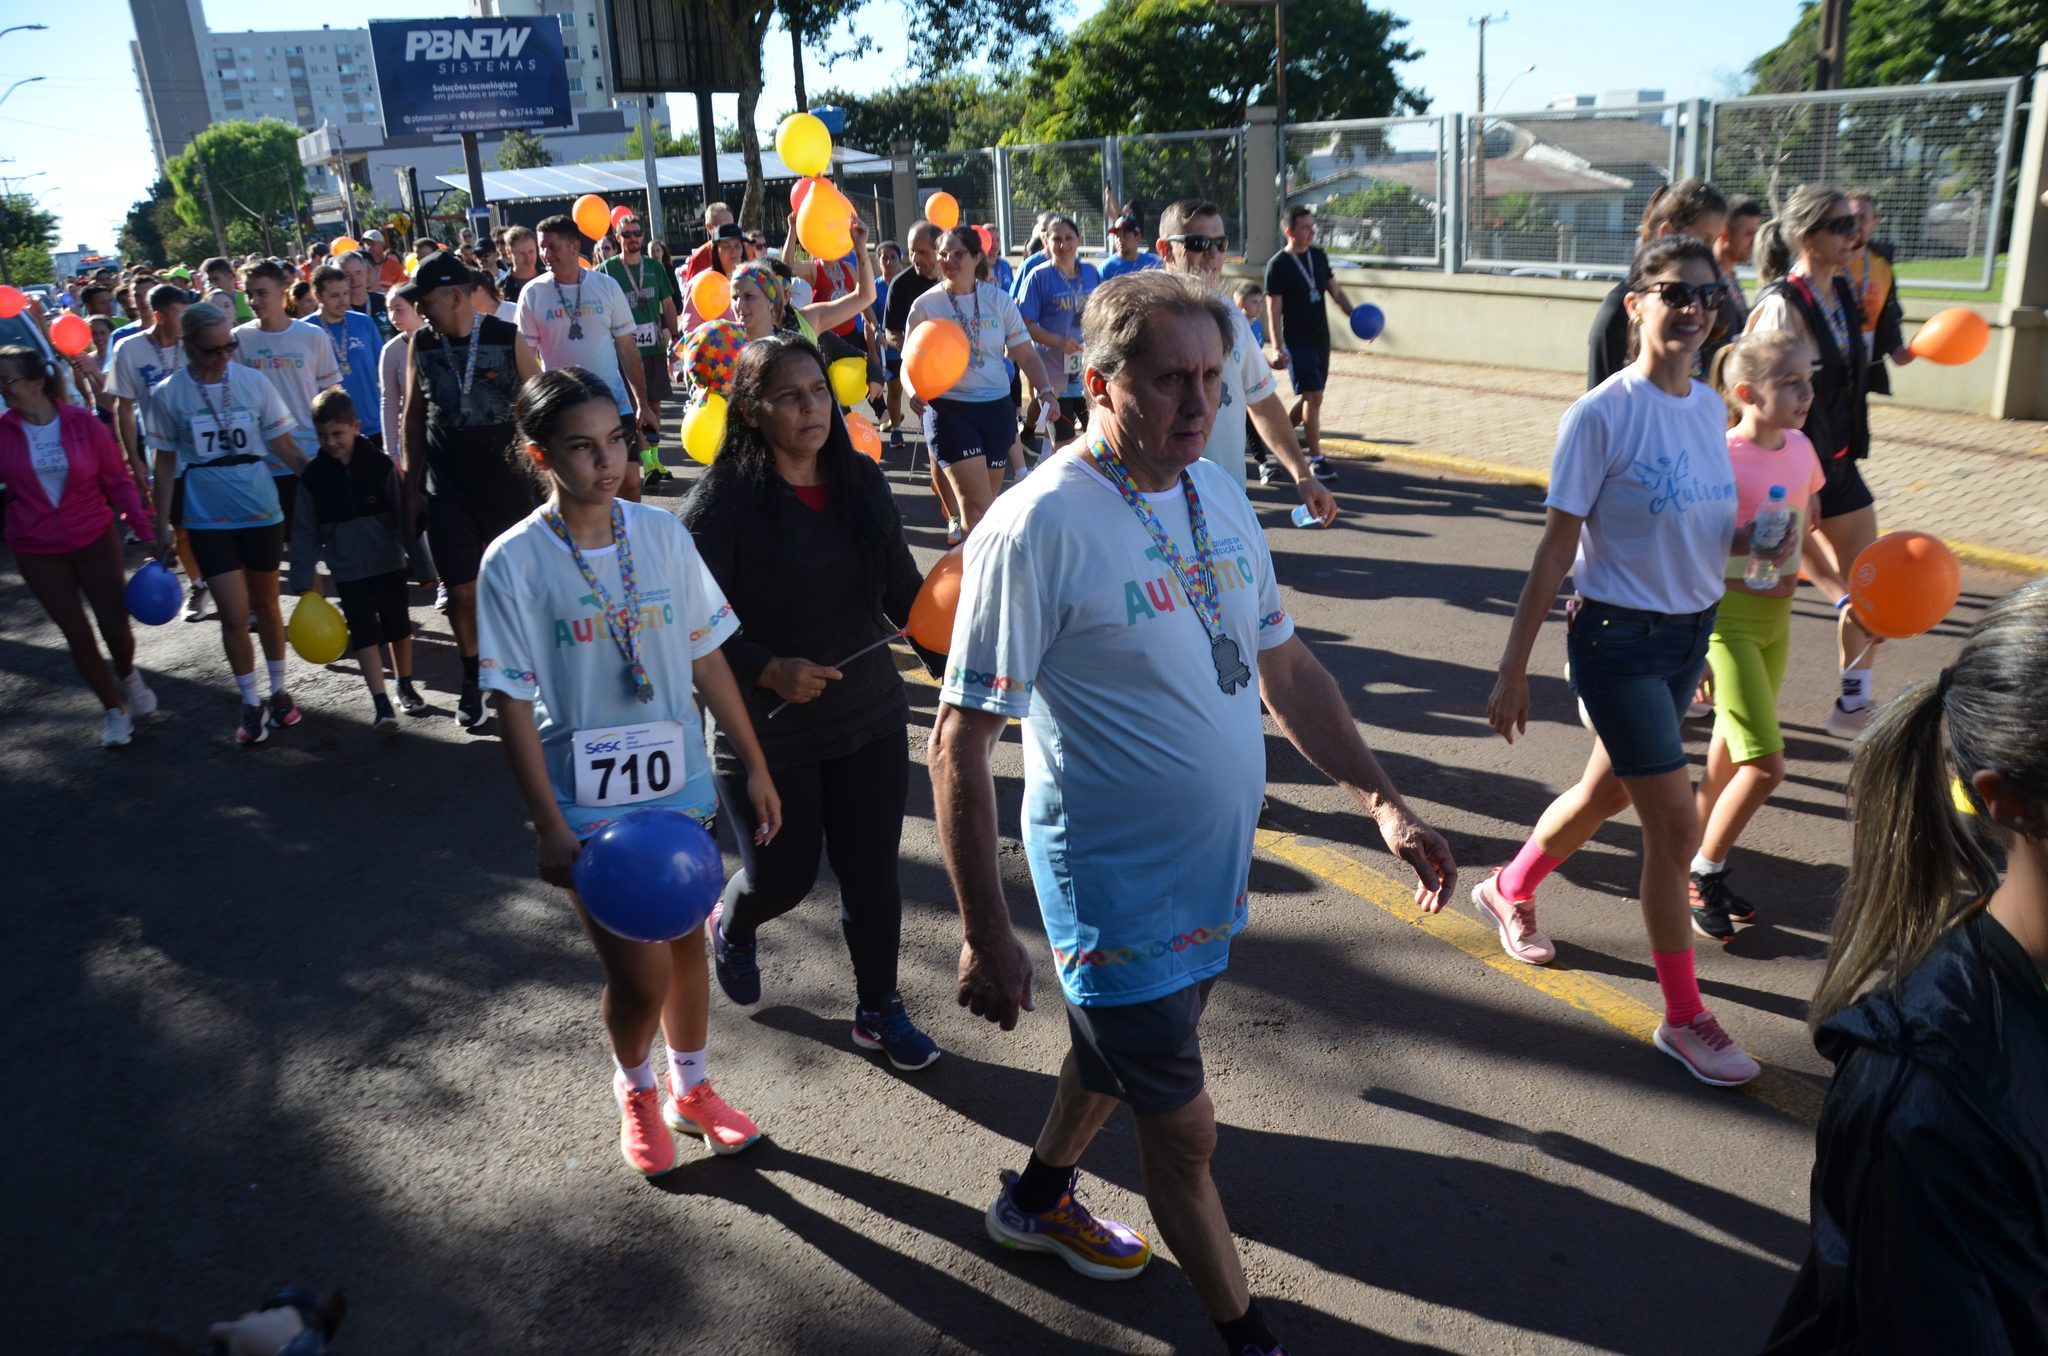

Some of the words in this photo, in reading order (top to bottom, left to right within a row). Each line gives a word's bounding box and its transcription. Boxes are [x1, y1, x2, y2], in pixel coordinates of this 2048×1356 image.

[405, 27, 532, 62] PBNEW
[438, 59, 536, 75] SISTEMAS
[962, 447, 982, 457] RUN
[590, 749, 671, 800] 710
